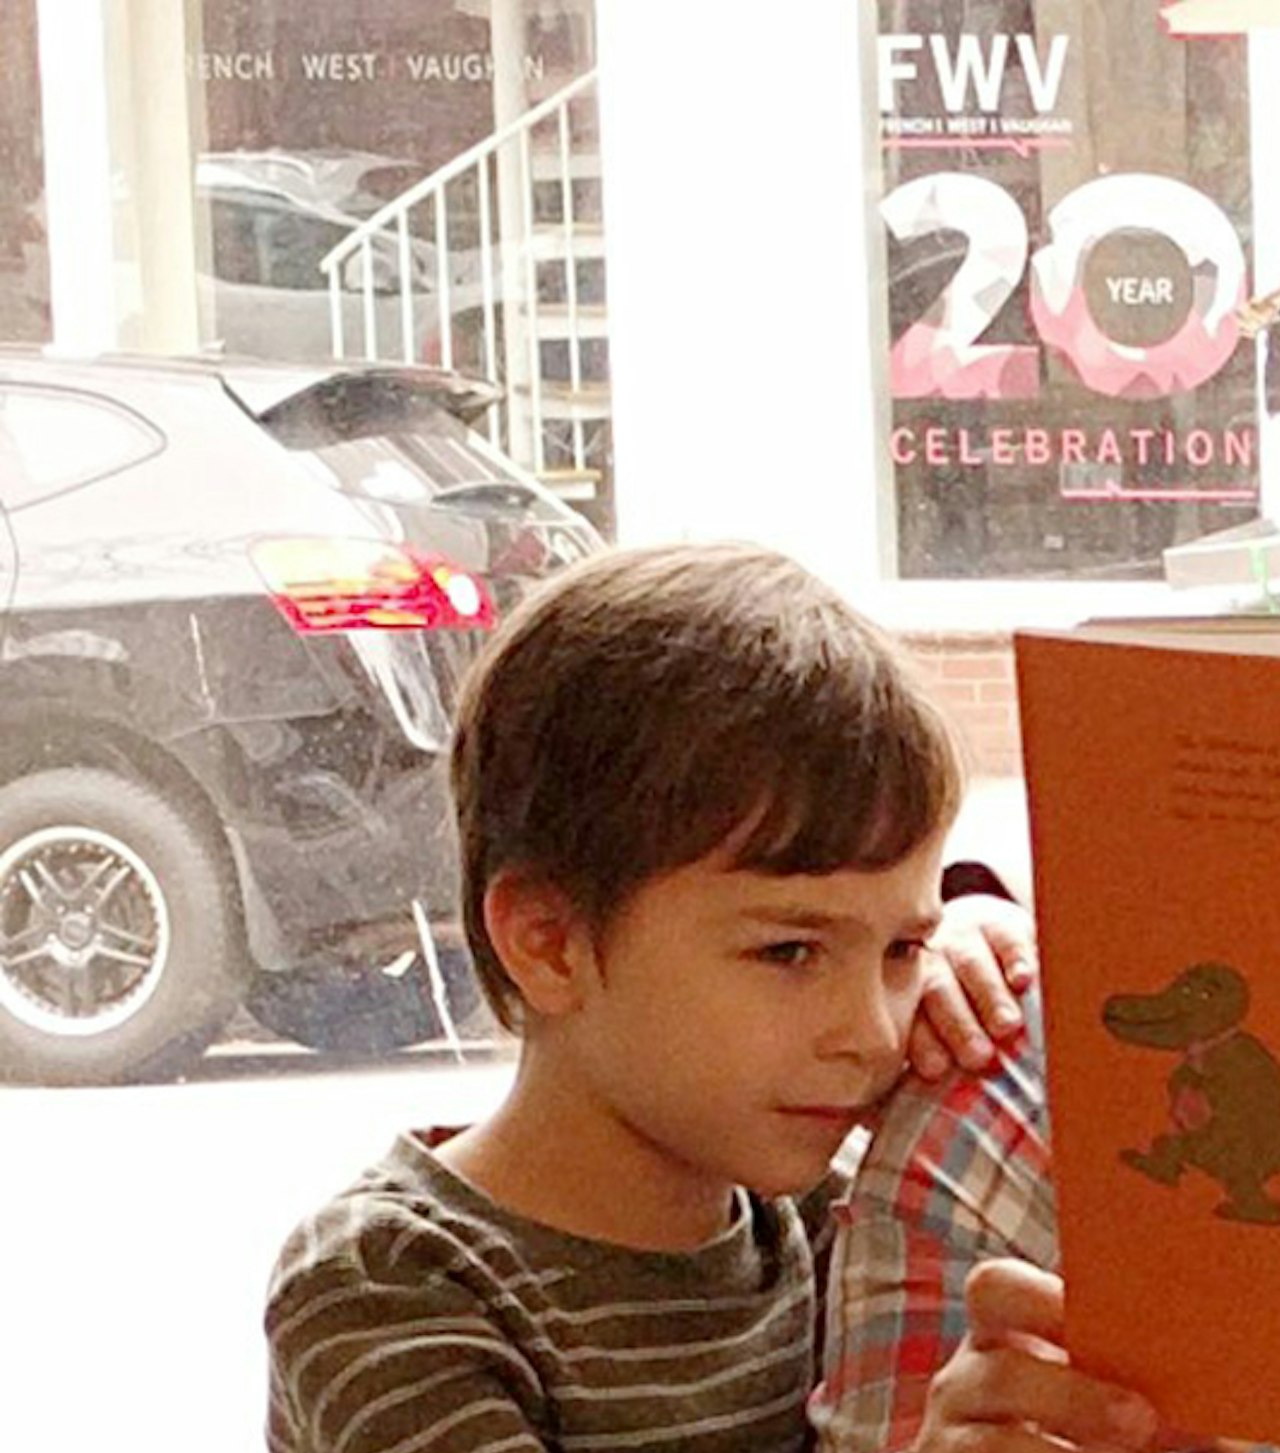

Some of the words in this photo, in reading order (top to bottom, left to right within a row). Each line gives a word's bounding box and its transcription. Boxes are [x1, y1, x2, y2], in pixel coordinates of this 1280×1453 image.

[184, 53, 275, 81] ENCH
[302, 53, 379, 81] WEST
[876, 33, 1070, 113] FWV
[877, 171, 1248, 401] 20
[1105, 276, 1173, 304] YEAR
[889, 427, 1252, 465] CELEBRATION
